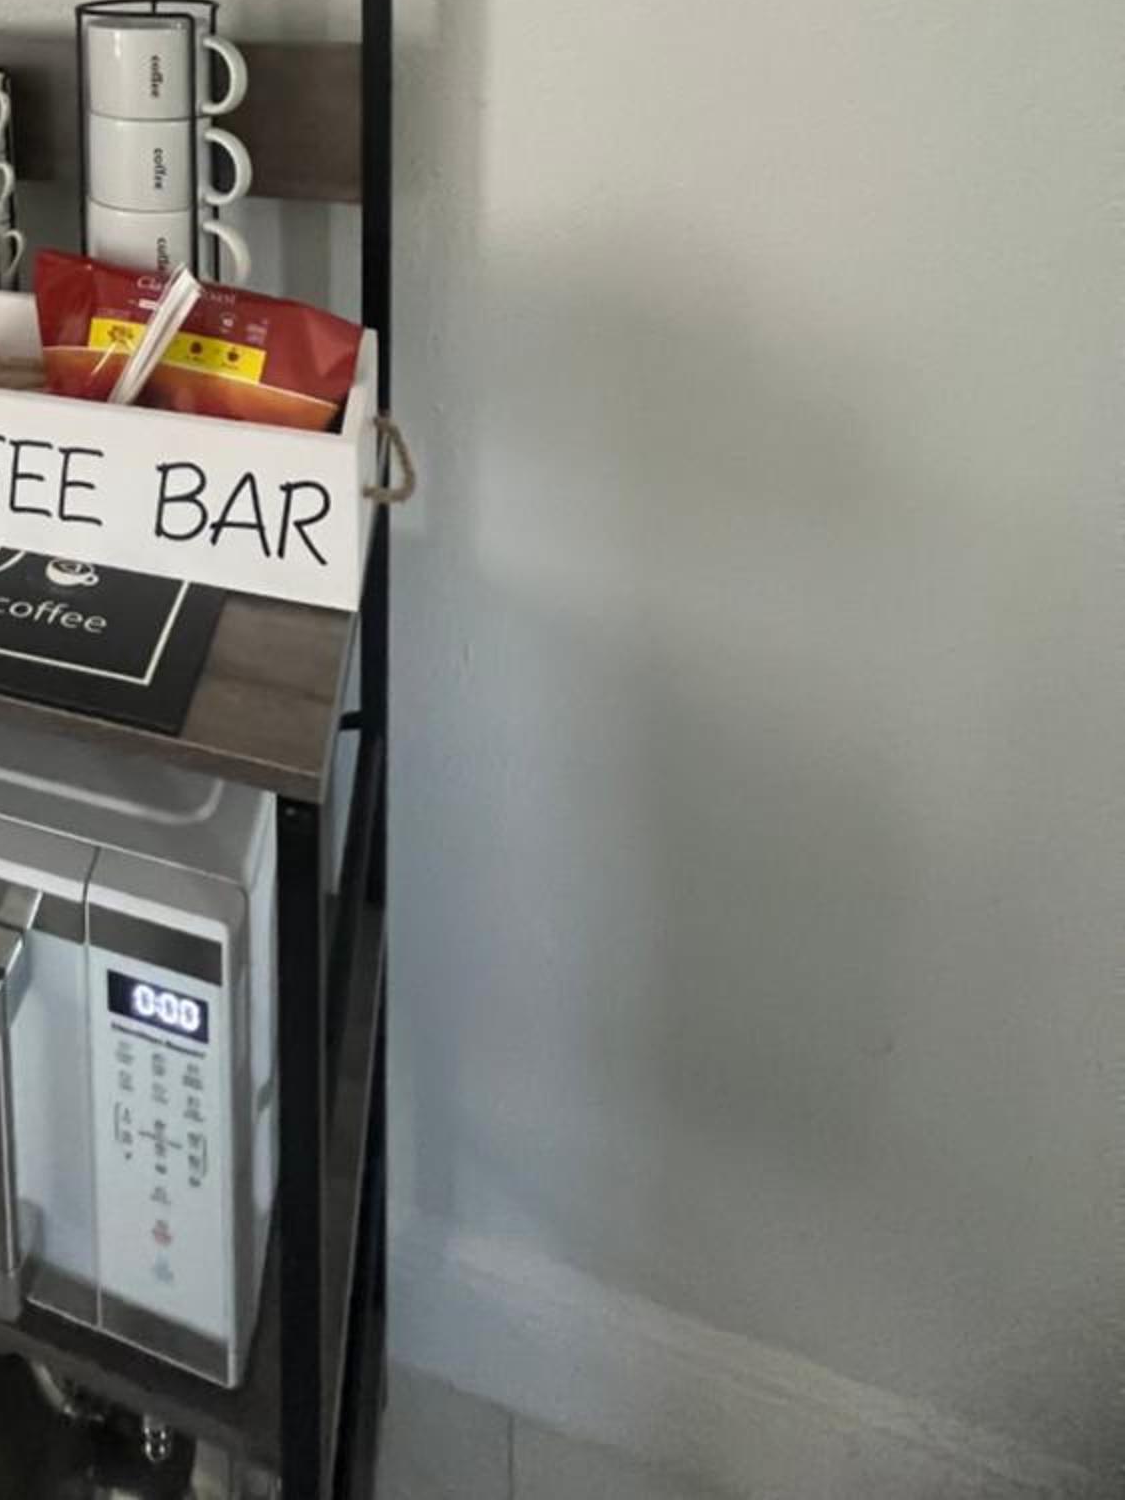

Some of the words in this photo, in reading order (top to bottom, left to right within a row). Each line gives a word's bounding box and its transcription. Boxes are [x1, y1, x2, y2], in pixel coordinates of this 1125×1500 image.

[153, 147, 167, 191] coffee
[156, 236, 170, 273] coffe
[155, 460, 333, 567] BAR
